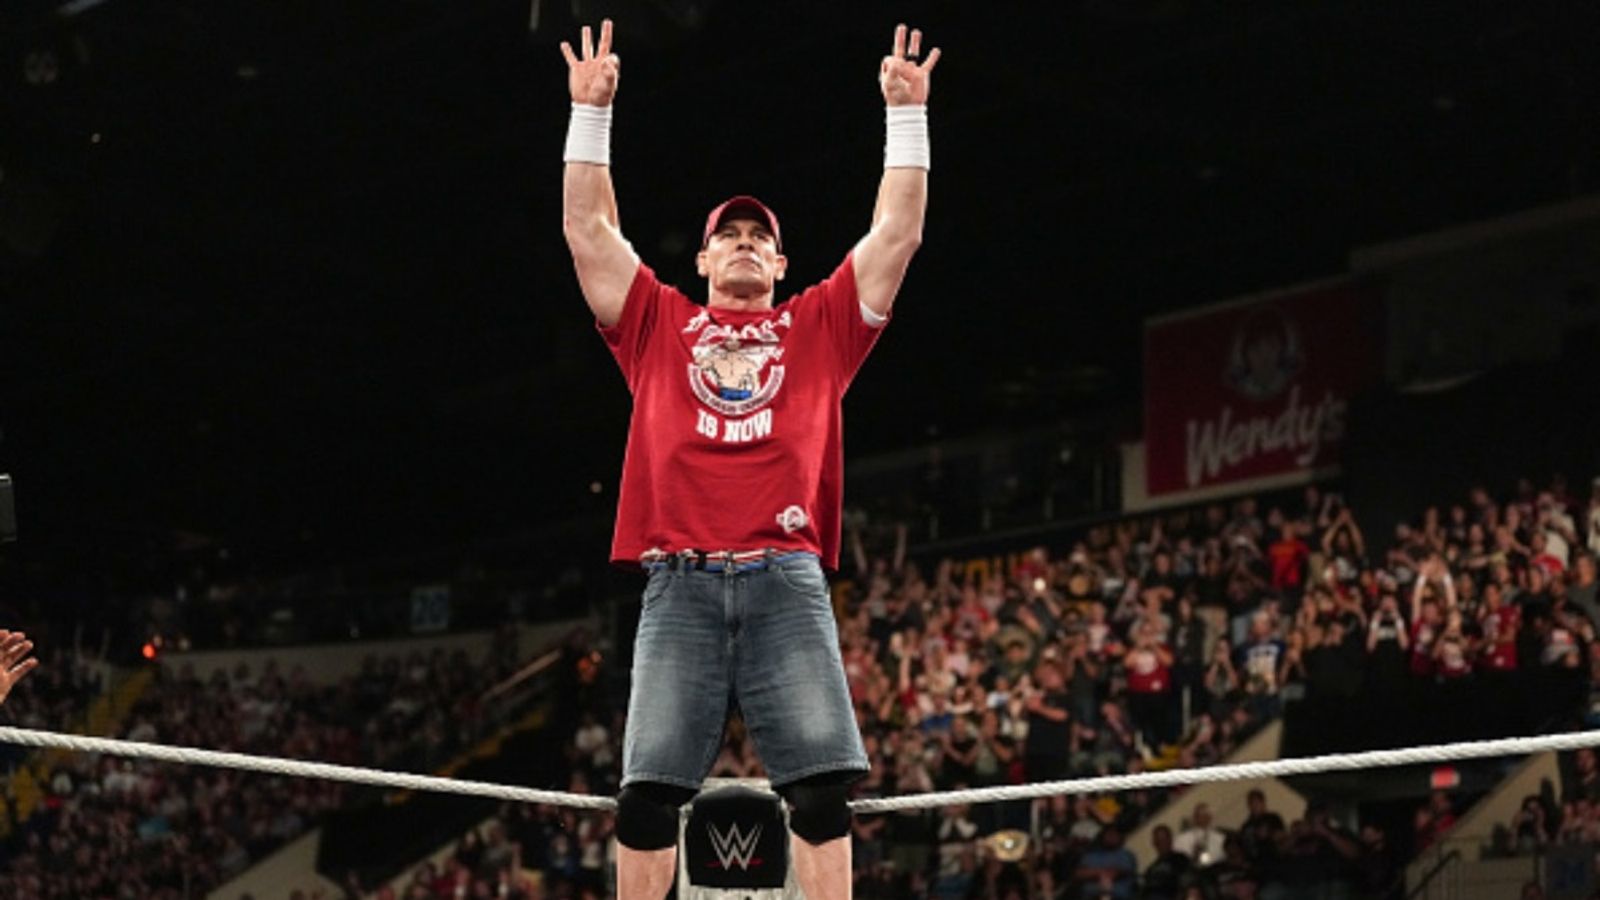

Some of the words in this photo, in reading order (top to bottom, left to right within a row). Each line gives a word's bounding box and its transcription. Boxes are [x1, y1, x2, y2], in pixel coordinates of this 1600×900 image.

[696, 408, 718, 439] IS
[722, 408, 772, 442] NOW
[1186, 385, 1347, 487] Wendy's
